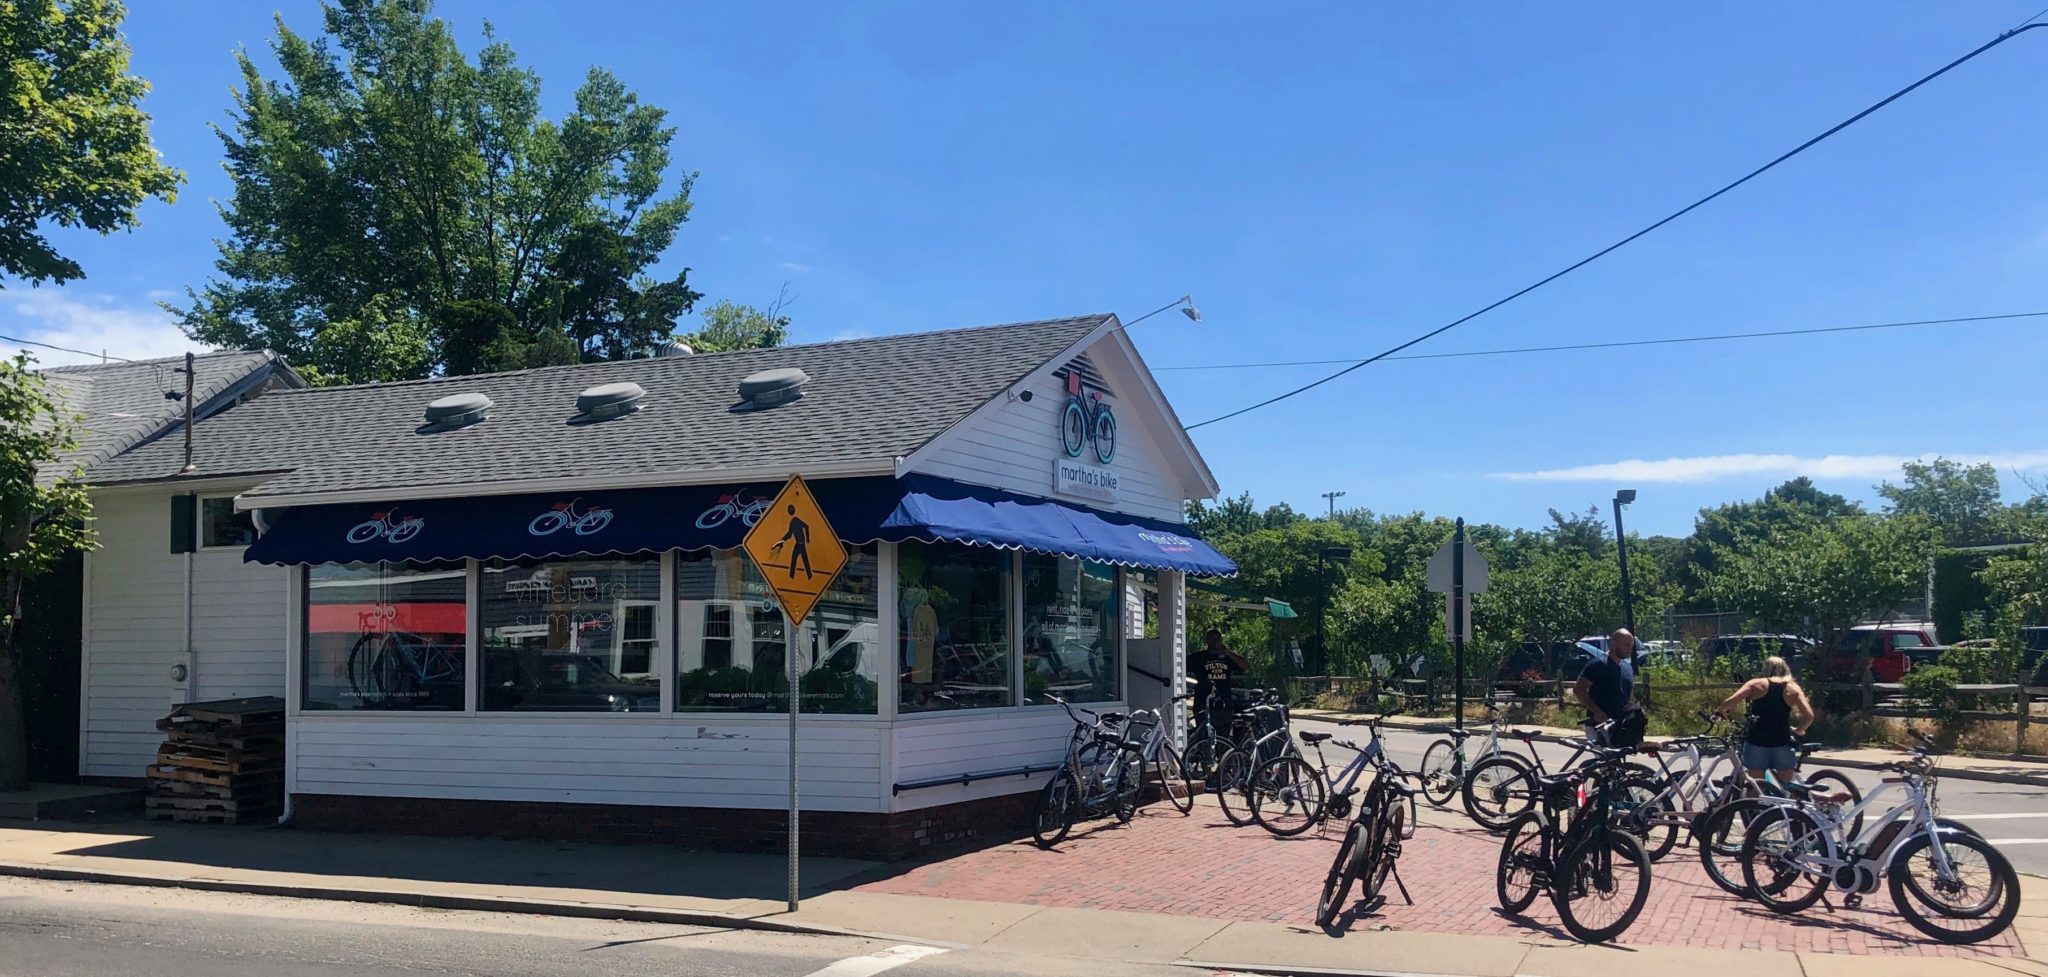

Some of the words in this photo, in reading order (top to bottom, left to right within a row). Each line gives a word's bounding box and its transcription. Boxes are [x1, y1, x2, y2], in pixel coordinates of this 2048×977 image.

[1061, 466, 1098, 486] martha's
[1100, 471, 1117, 490] bike
[515, 574, 627, 608] vineyard
